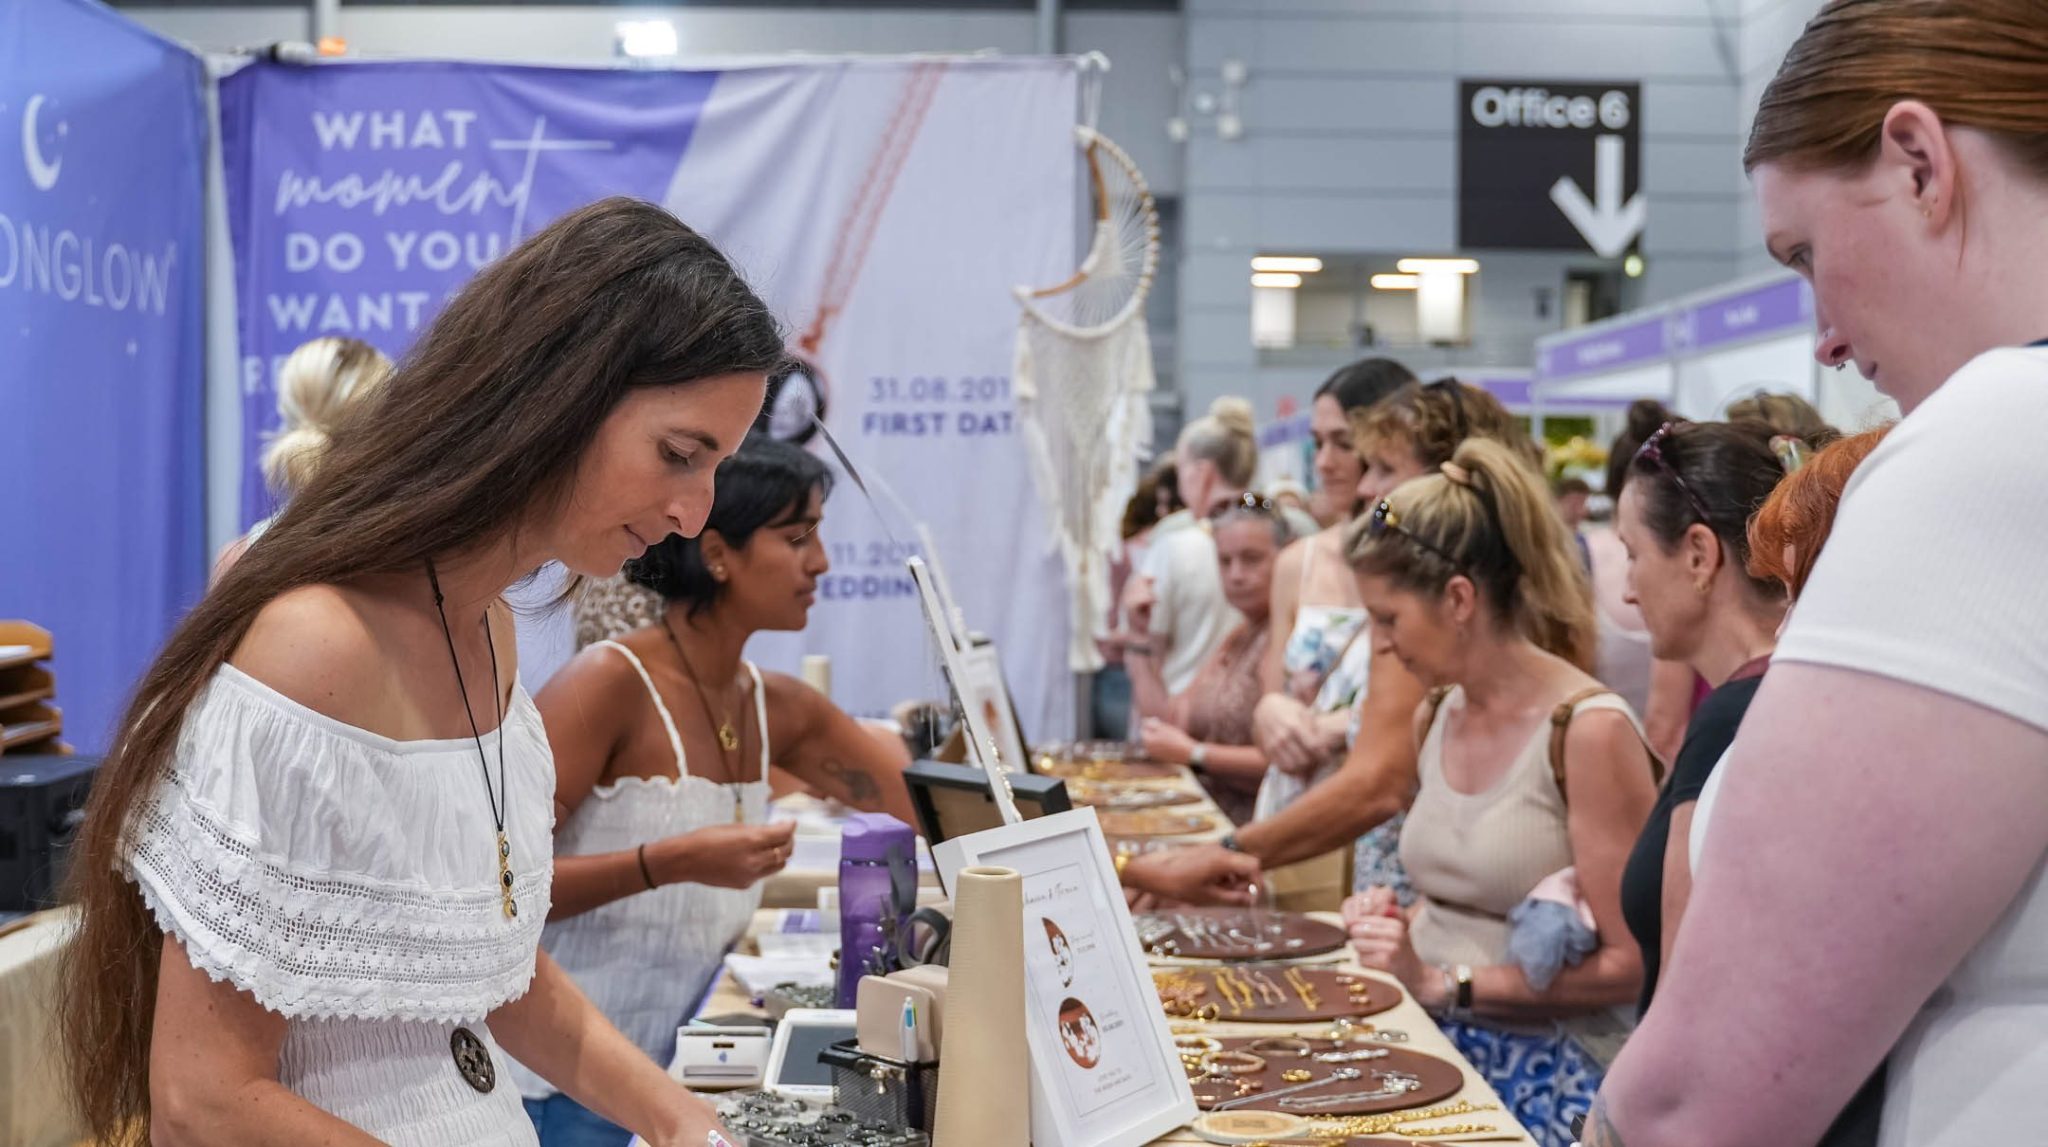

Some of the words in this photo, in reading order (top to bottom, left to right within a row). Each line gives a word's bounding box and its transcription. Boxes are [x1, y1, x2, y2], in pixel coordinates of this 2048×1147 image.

[1471, 86, 1597, 128] Office
[1599, 89, 1631, 130] 6
[312, 109, 477, 151] WHAT
[285, 231, 365, 272] DO
[386, 230, 502, 272] YOU
[267, 292, 430, 332] WANT
[862, 412, 945, 436] FIRST
